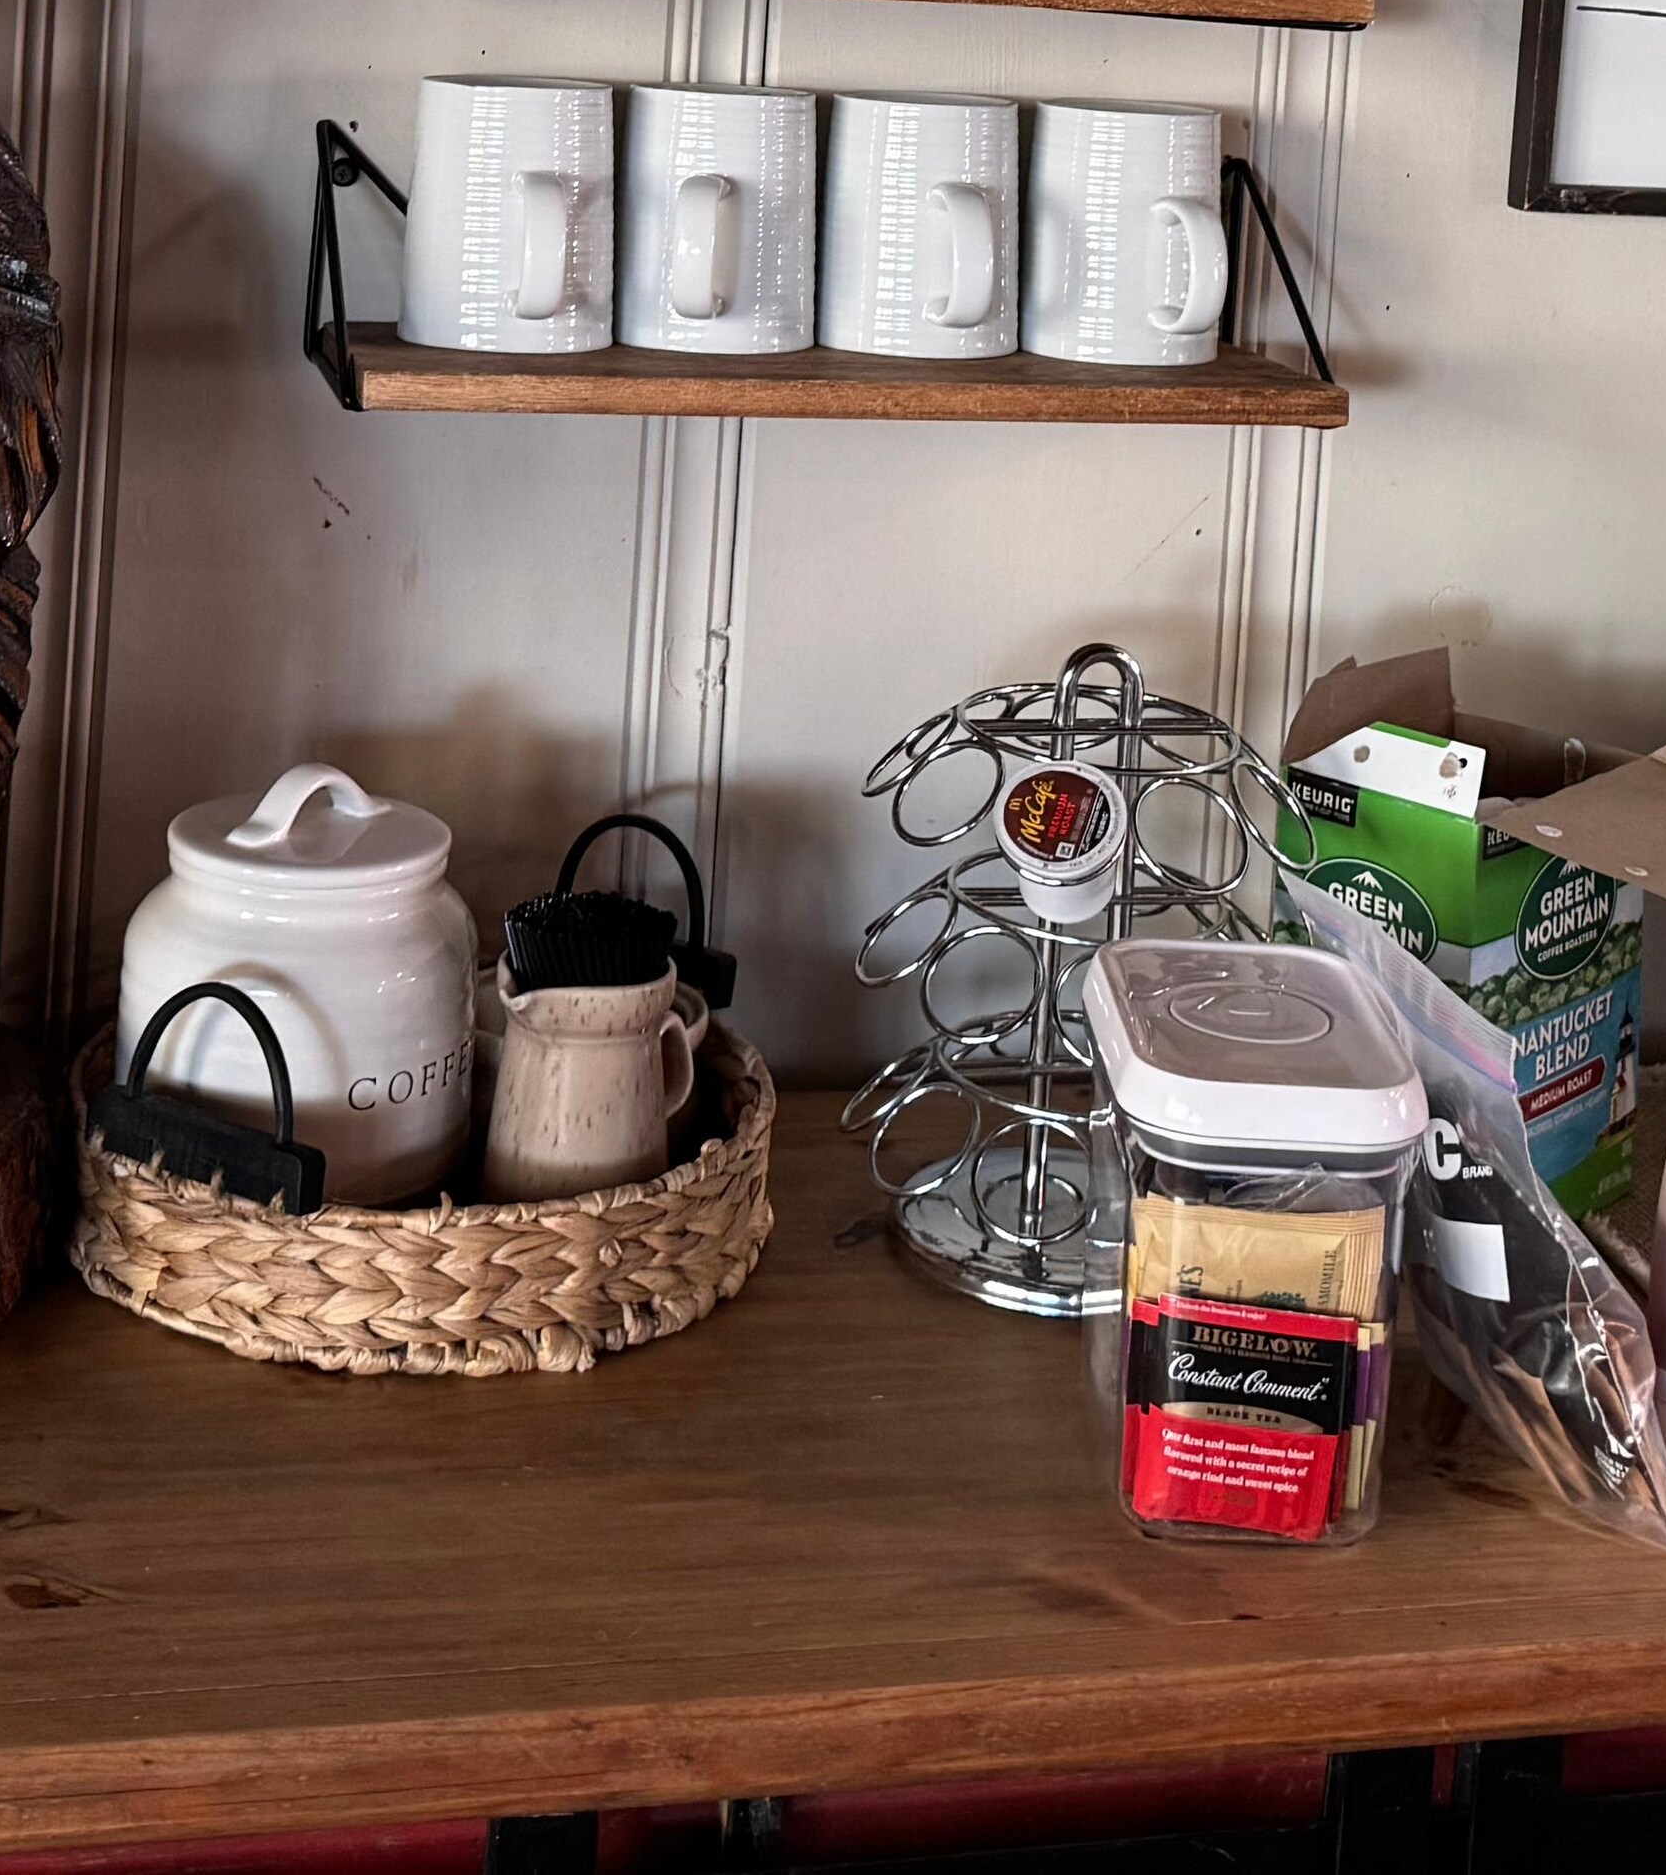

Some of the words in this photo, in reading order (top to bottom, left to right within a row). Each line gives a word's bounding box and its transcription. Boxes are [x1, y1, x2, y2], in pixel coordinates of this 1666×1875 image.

[1292, 781, 1352, 814] KEURIG
[1328, 882, 1404, 923] GREEN
[1540, 872, 1595, 916] GREEN
[1524, 892, 1609, 952] MOUNTAIN
[1537, 943, 1564, 963] COFFEE
[1514, 990, 1613, 1058] NANTUCKET
[348, 1039, 471, 1111] COFFE
[1535, 1034, 1591, 1081] BLEND
[1530, 1083, 1566, 1112] MEDIUM
[1566, 1068, 1593, 1094] ROAST
[1193, 1324, 1317, 1357] BIGELOW
